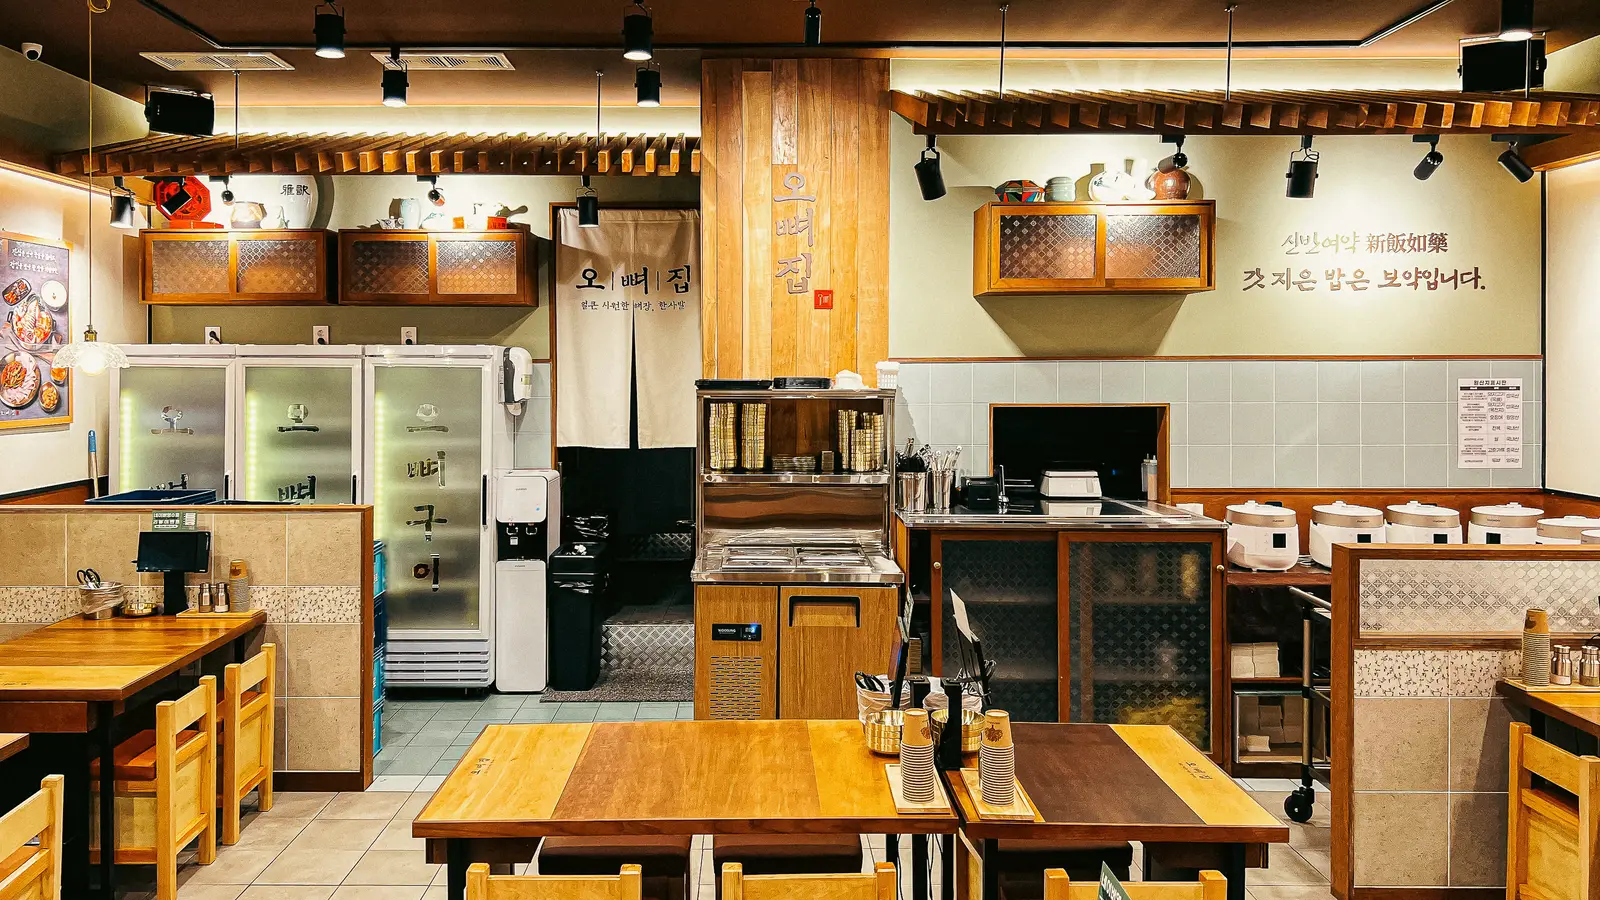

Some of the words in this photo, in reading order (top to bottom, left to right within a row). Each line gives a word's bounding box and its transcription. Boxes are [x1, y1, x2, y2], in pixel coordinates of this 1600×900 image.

[774, 172, 816, 294] 오뼈집
[1367, 232, 1448, 254] 新飯如藥
[1271, 267, 1317, 291] 지은
[1325, 267, 1370, 291] 밥은
[1378, 267, 1486, 291] 보약입니다.
